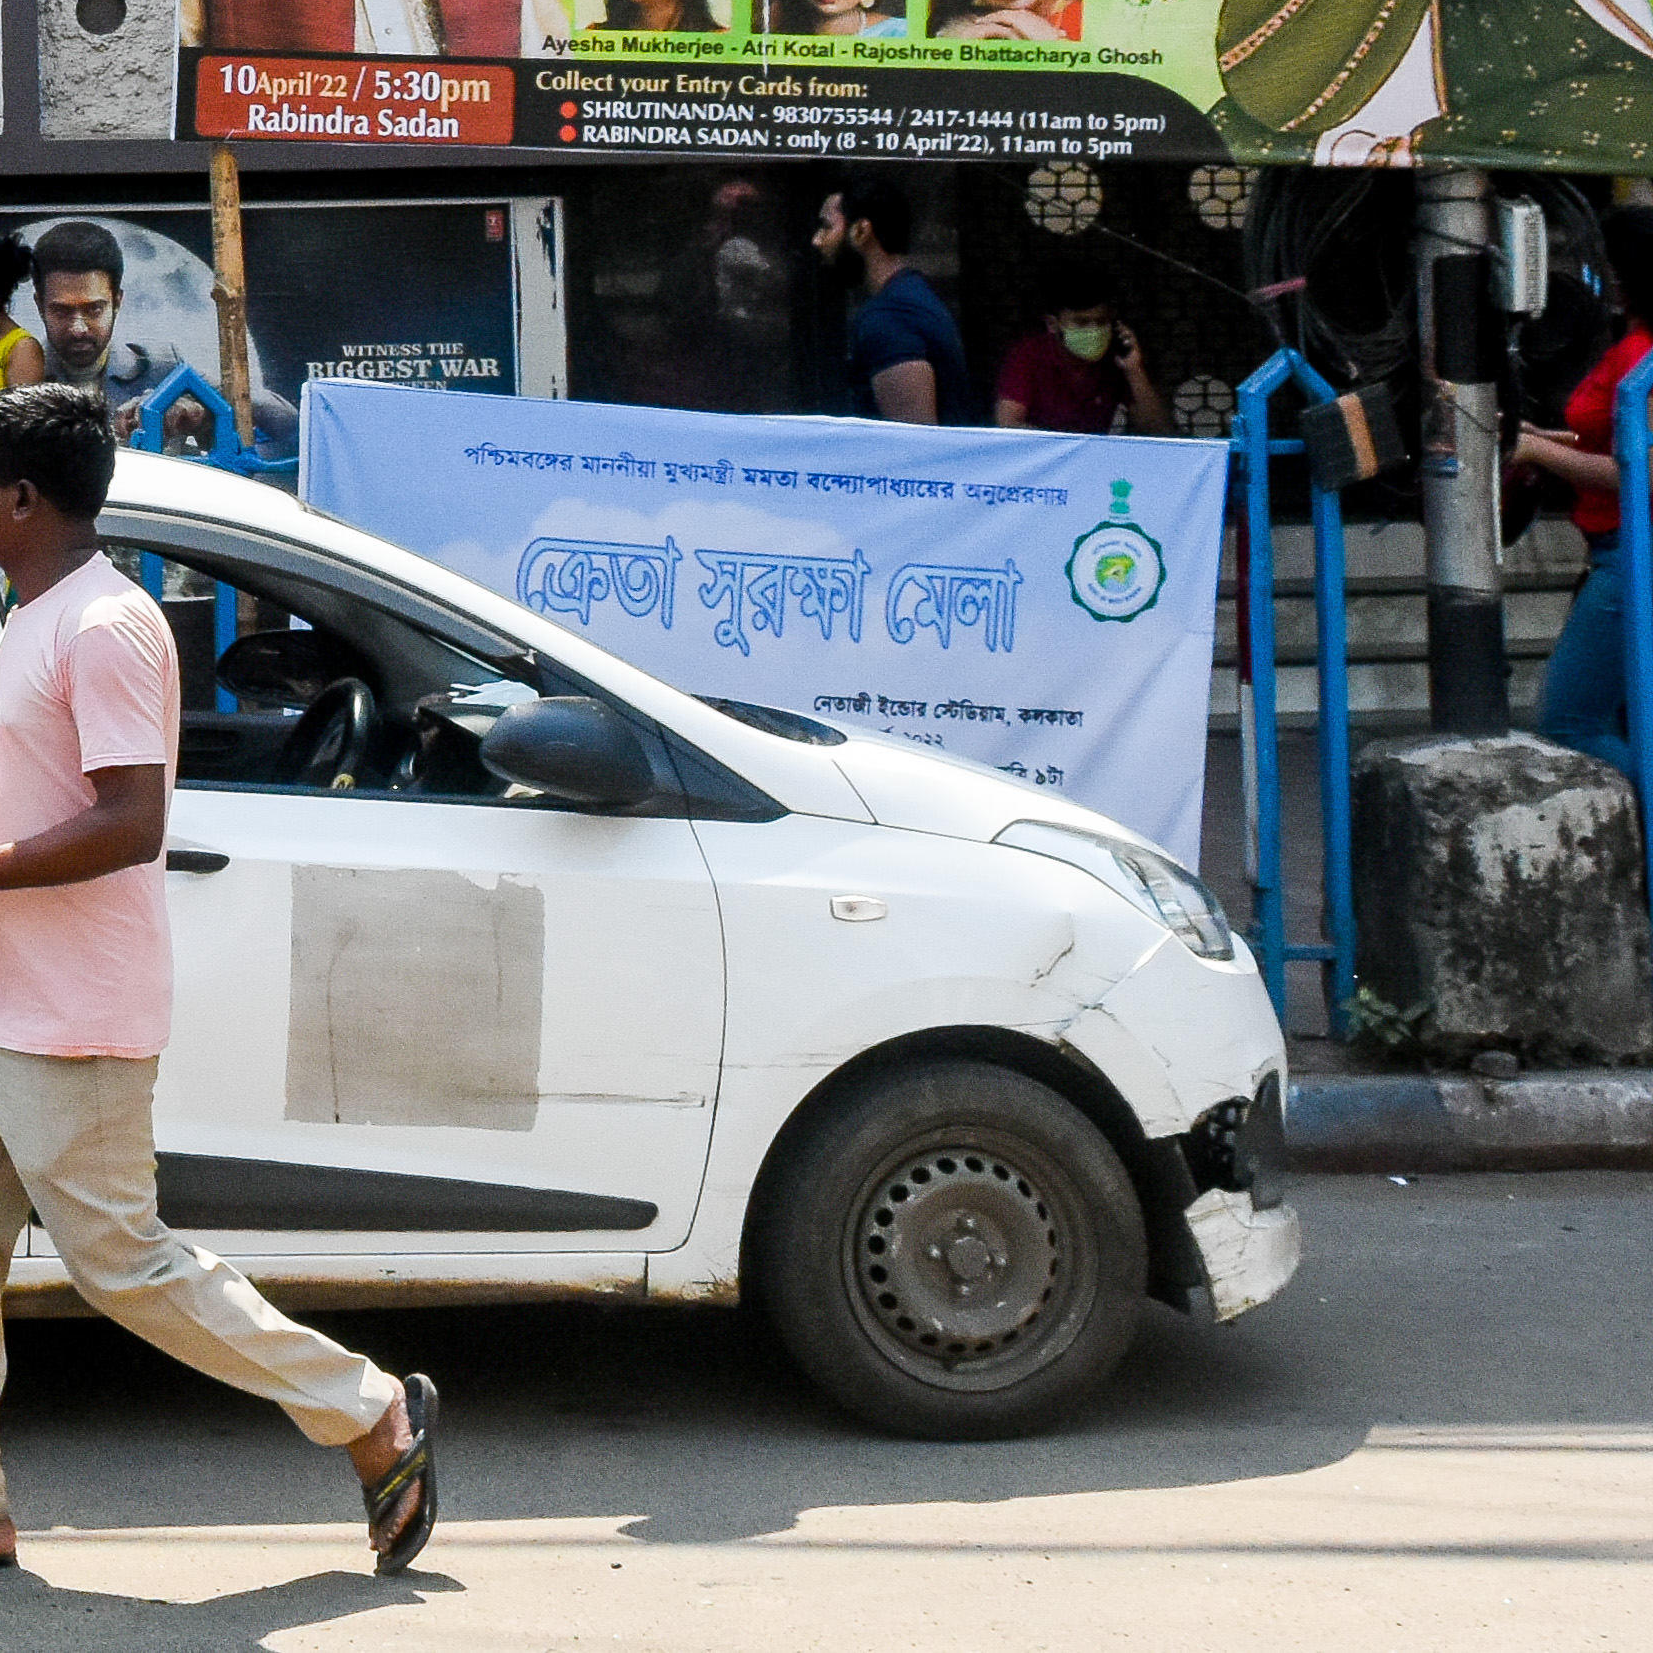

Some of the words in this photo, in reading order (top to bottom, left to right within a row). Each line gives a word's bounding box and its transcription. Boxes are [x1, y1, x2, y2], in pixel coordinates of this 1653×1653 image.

[541, 34, 616, 60] Ayesha
[622, 37, 723, 61] Mukherjee
[742, 40, 777, 58] Atri
[784, 41, 834, 58] Kotal
[853, 41, 952, 65] Rajoshree
[959, 44, 1093, 67] Bhattacharya
[1097, 48, 1163, 65] Ghosh
[374, 70, 490, 112] 5:30pm
[536, 70, 613, 91] Collect
[620, 78, 669, 98] your
[676, 74, 732, 100] Entry
[738, 75, 802, 96] Cards
[808, 76, 867, 97] from:
[248, 103, 370, 135] Rabindra
[378, 108, 458, 137] Sadan
[583, 101, 754, 121] SHRUTINANDAN
[773, 106, 893, 125] 9830755544
[910, 109, 1013, 128] 2417-1444
[1019, 109, 1080, 133] (11am
[1087, 113, 1108, 130] to
[1111, 111, 1166, 134] 5pm)
[342, 344, 422, 357] WITNESS
[427, 343, 463, 355] THE
[306, 360, 432, 379] BIGGEST
[440, 359, 500, 377] WAR
[464, 442, 572, 472] পশ্চিমবঙ্গের
[583, 451, 656, 479] মাননীয়া
[742, 466, 798, 489] মমতা
[886, 558, 1023, 653] মেলা
